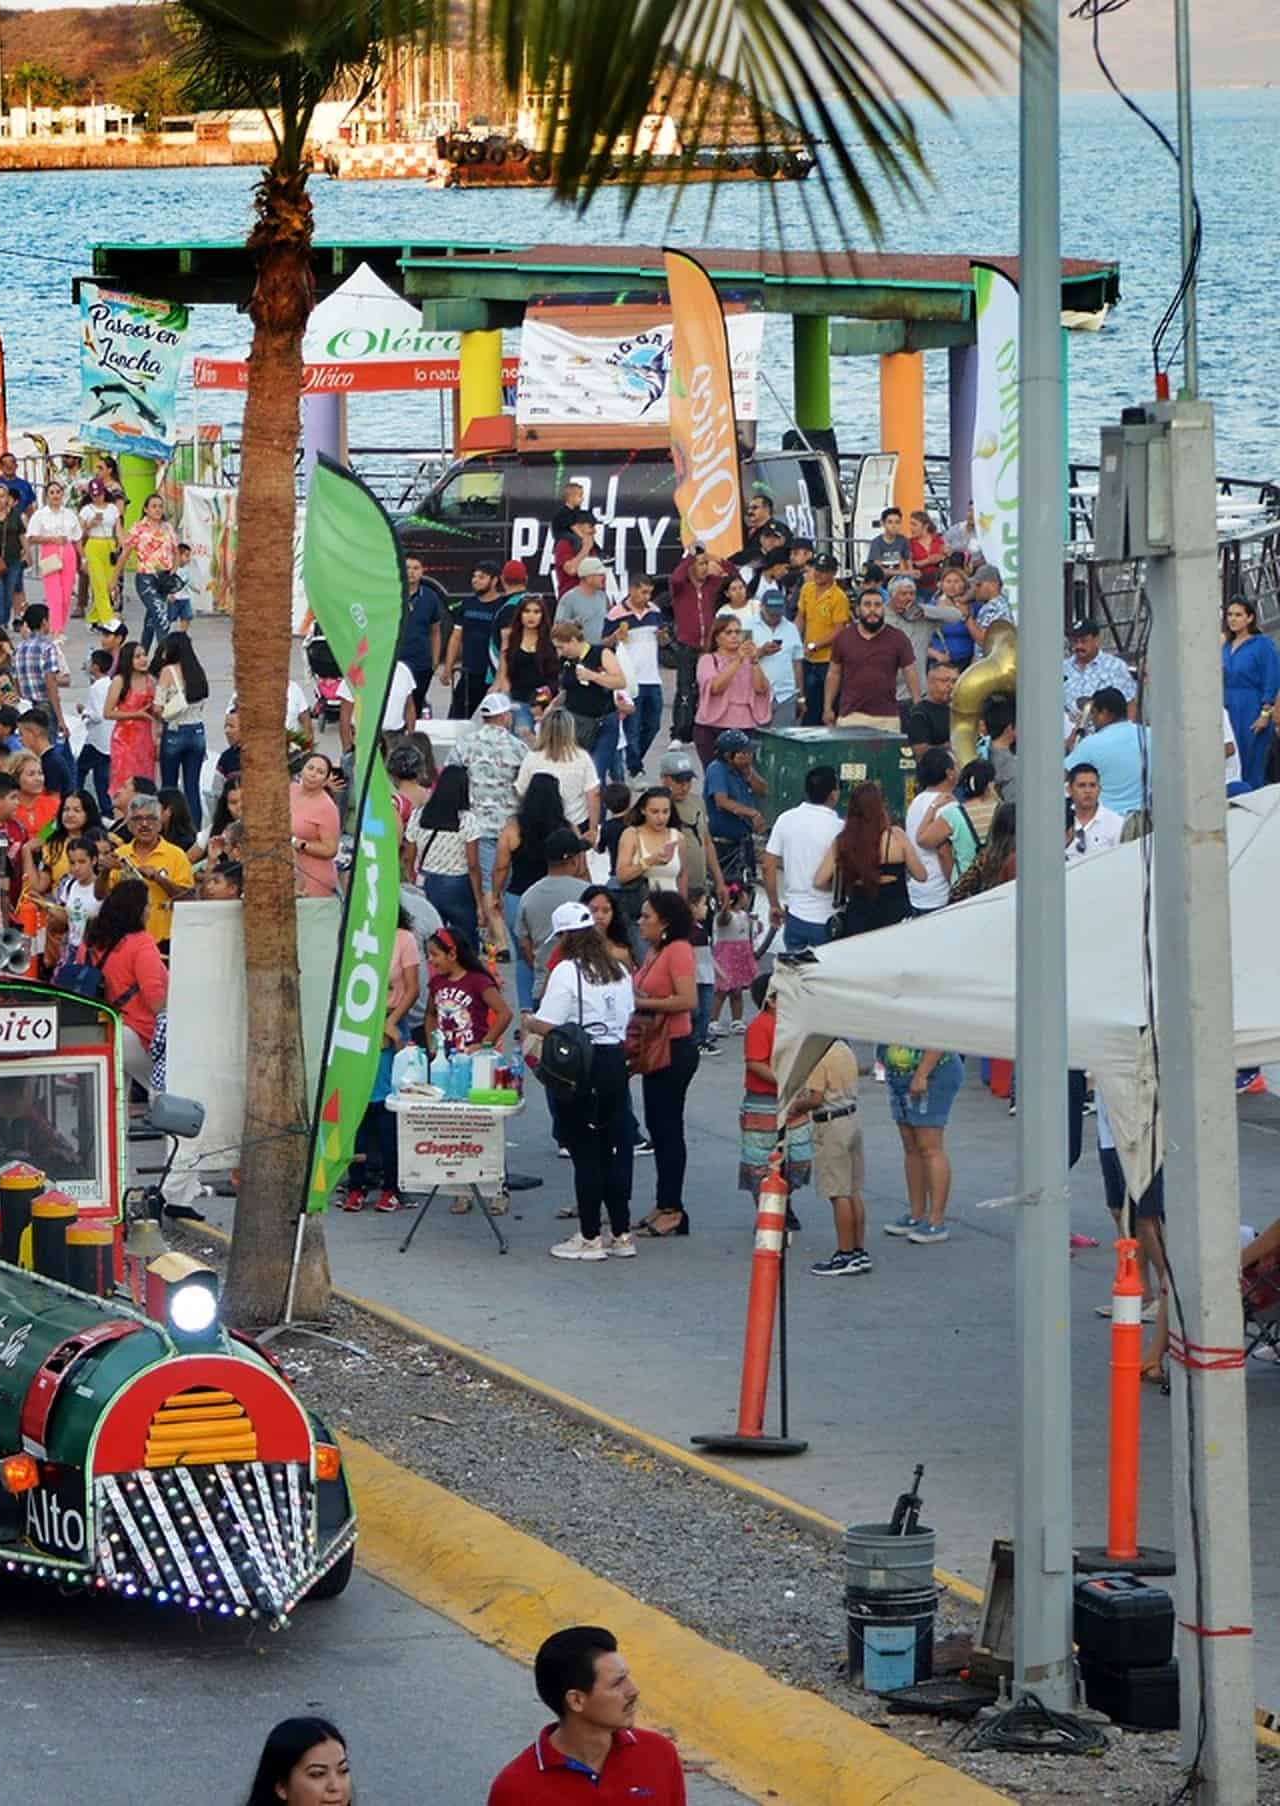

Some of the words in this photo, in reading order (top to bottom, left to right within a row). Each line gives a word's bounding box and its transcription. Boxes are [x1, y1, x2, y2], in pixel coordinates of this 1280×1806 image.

[88, 303, 156, 340] Paseos
[97, 337, 163, 384] Lancha
[429, 366, 461, 381] natu
[511, 516, 671, 577] PTY
[26, 1488, 85, 1552] Alto
